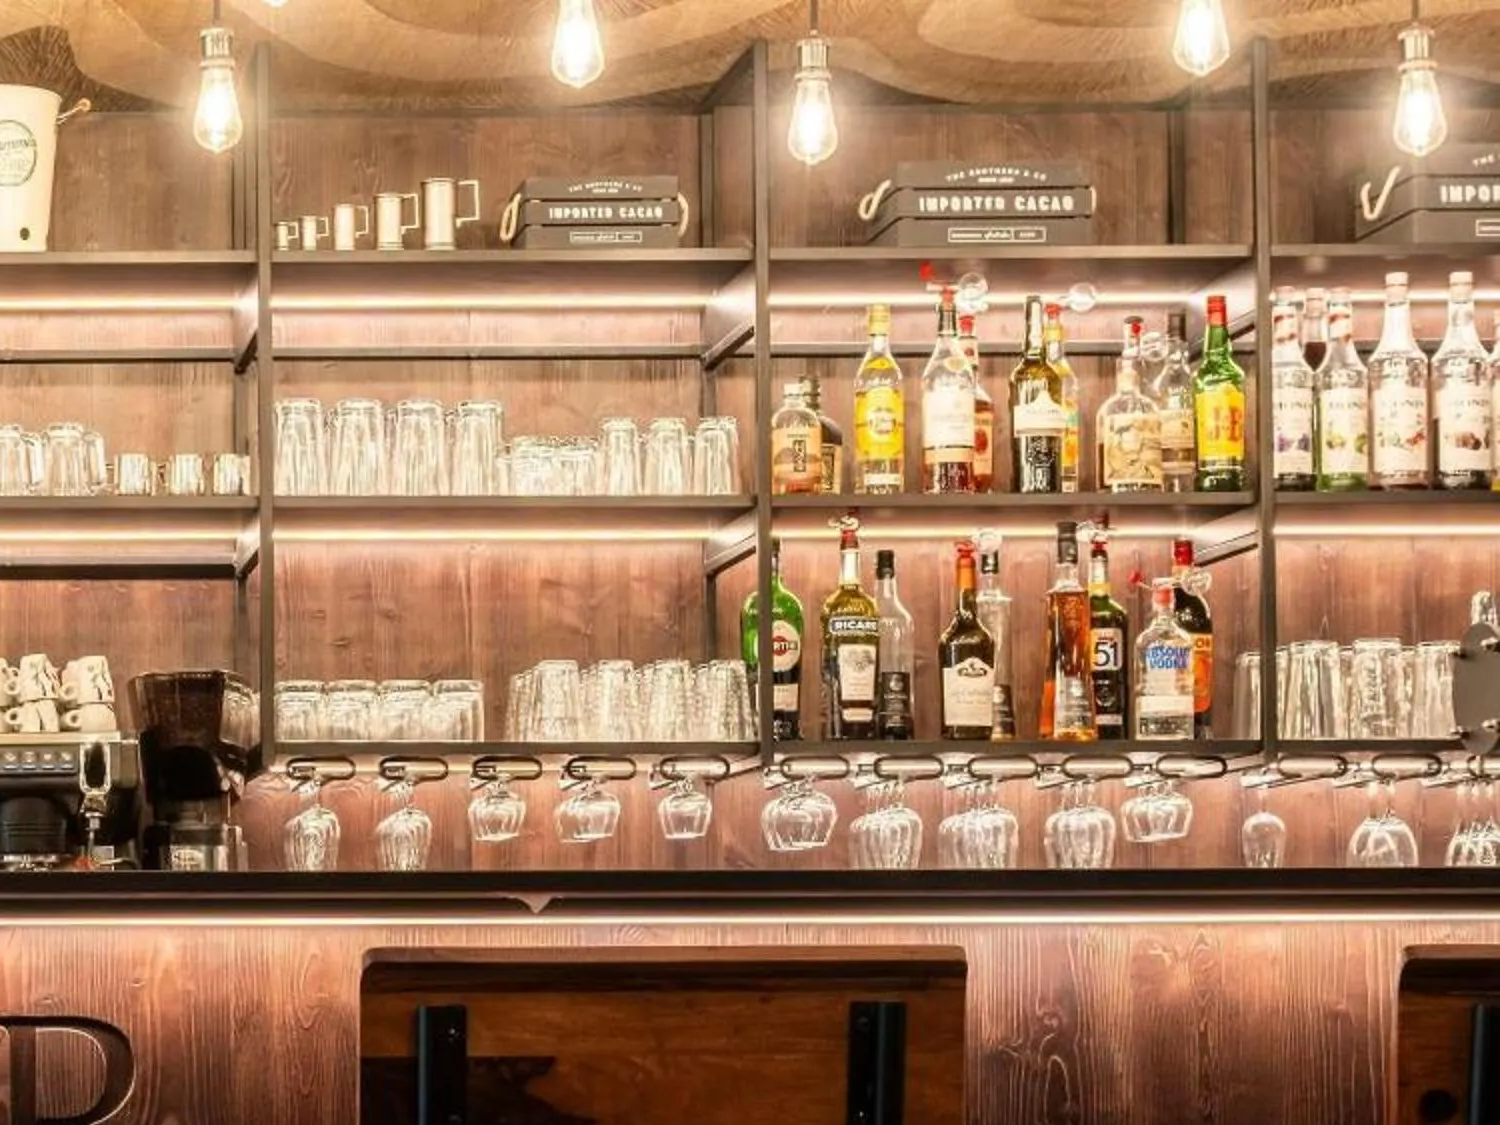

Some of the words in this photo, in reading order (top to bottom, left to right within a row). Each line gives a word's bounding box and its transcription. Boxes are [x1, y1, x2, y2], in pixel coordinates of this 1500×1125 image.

[919, 195, 1005, 212] IMPORTED
[1014, 195, 1074, 212] CACAO
[549, 207, 613, 219] IMPORTED
[619, 207, 663, 219] CACAO
[1094, 641, 1119, 668] 51
